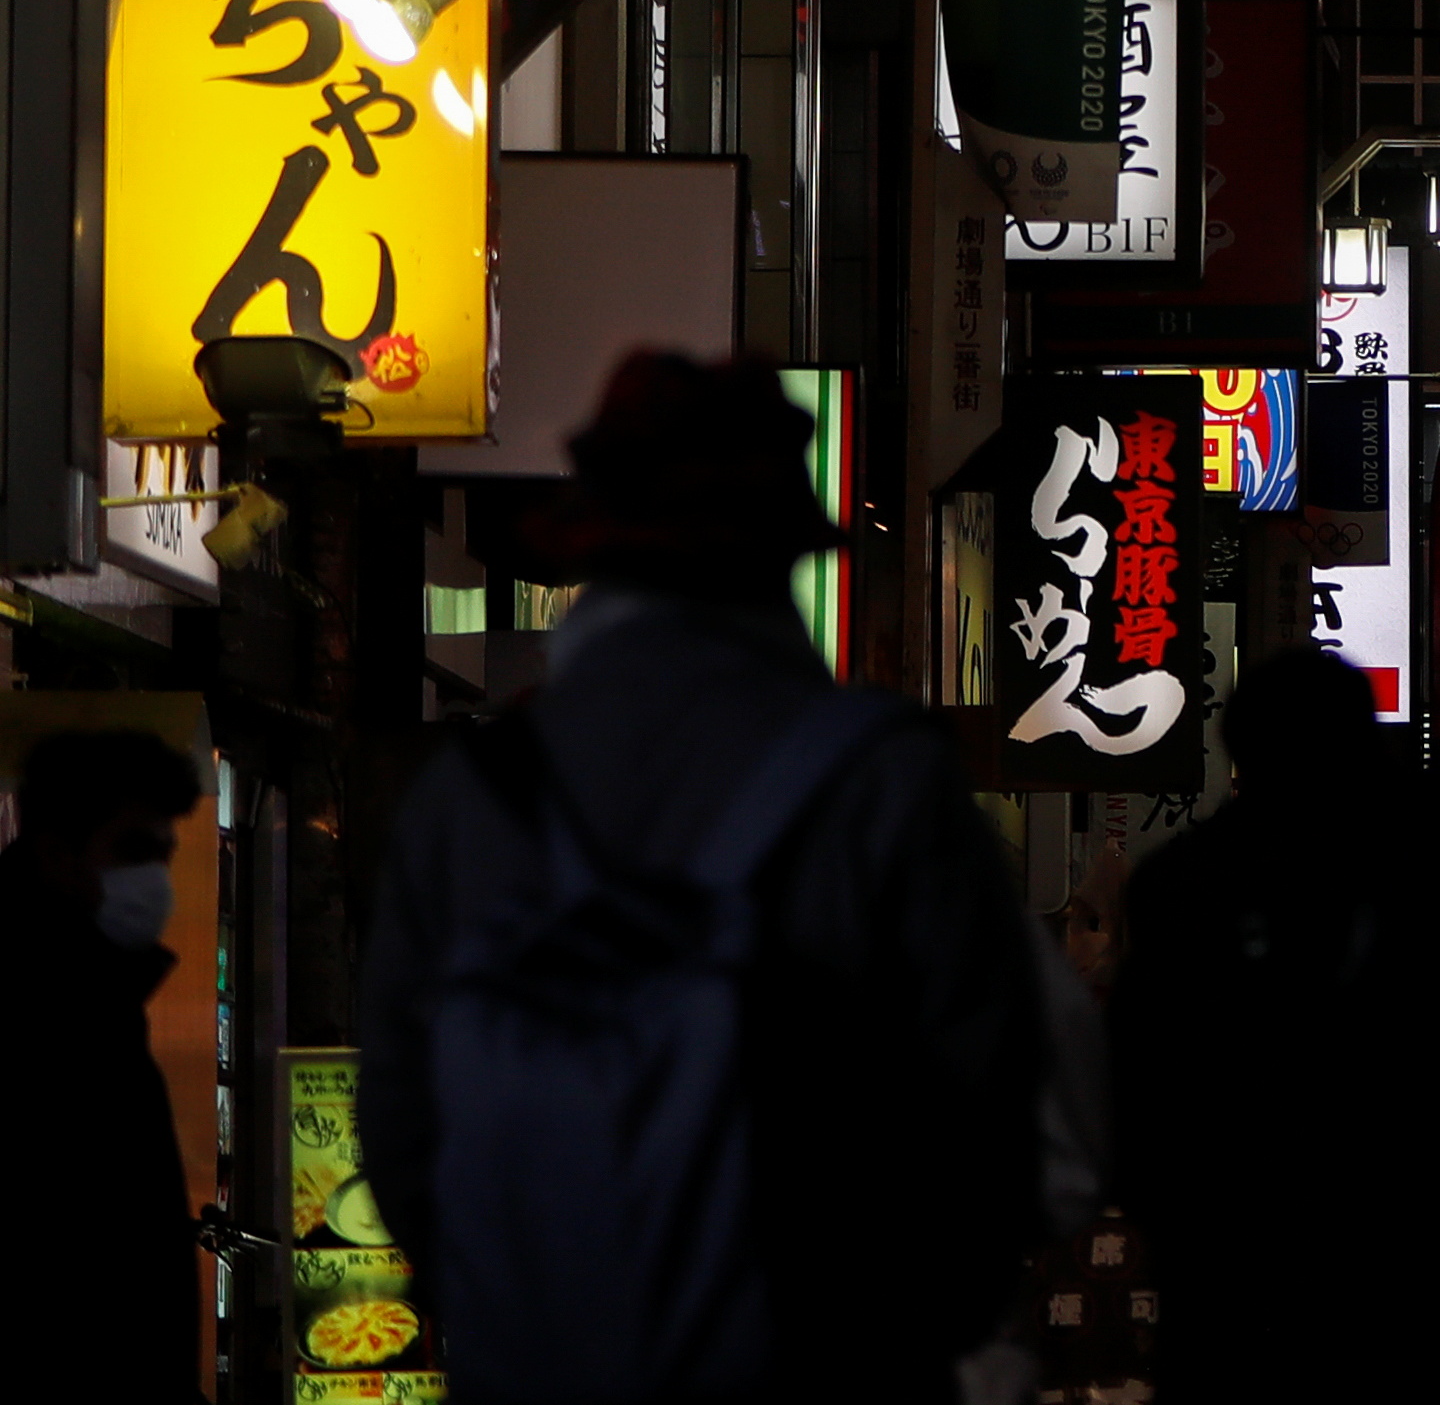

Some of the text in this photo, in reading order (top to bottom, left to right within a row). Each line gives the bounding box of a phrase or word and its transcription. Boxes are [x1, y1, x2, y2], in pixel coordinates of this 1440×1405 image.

[1080, 66, 1106, 133] 2020
[1084, 216, 1169, 254] B1F
[1112, 410, 1180, 668] 東京豚骨
